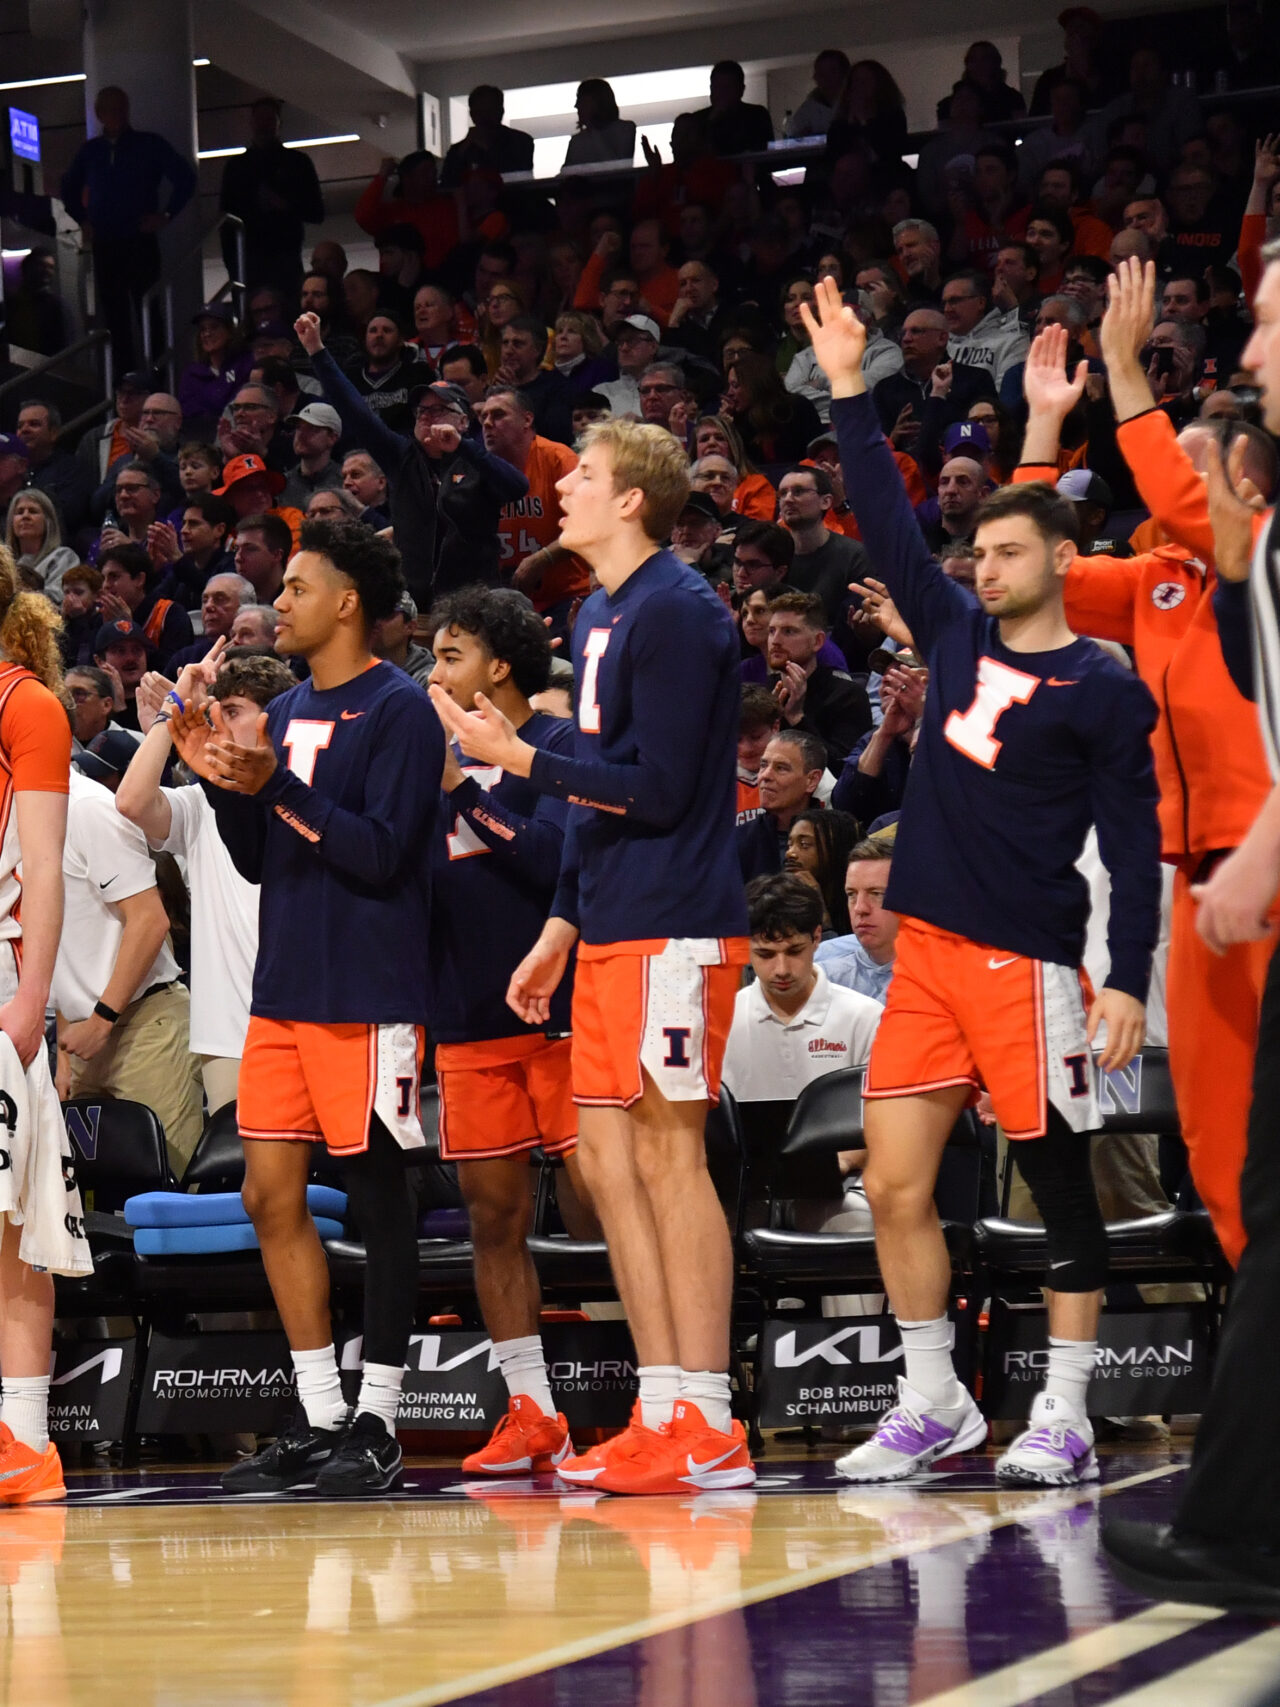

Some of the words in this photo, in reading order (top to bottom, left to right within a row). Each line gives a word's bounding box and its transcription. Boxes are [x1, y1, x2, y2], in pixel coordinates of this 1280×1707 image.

[960, 424, 972, 437] N
[500, 496, 544, 520] INOIS
[496, 529, 542, 559] 54
[580, 628, 612, 734] I
[944, 656, 1042, 770] I
[662, 1027, 691, 1068] I
[808, 1038, 847, 1052] Illinois
[1063, 1052, 1089, 1099] I
[1099, 1055, 1143, 1114] N
[396, 1077, 413, 1117] I
[775, 1326, 904, 1367] KI
[1004, 1339, 1193, 1375] RORMAN
[1131, 1365, 1193, 1379] GROUP
[156, 1387, 253, 1399] AUTOMOTIVE
[260, 1386, 299, 1398] GRO
[550, 1380, 637, 1391] TOMOTIVE
[799, 1387, 834, 1400] BOB
[839, 1383, 898, 1399] ROHRM
[399, 1392, 477, 1405] ROHRMAN
[47, 1405, 91, 1417] RMAN
[459, 1407, 486, 1420] KIA
[74, 1418, 100, 1431] KIA
